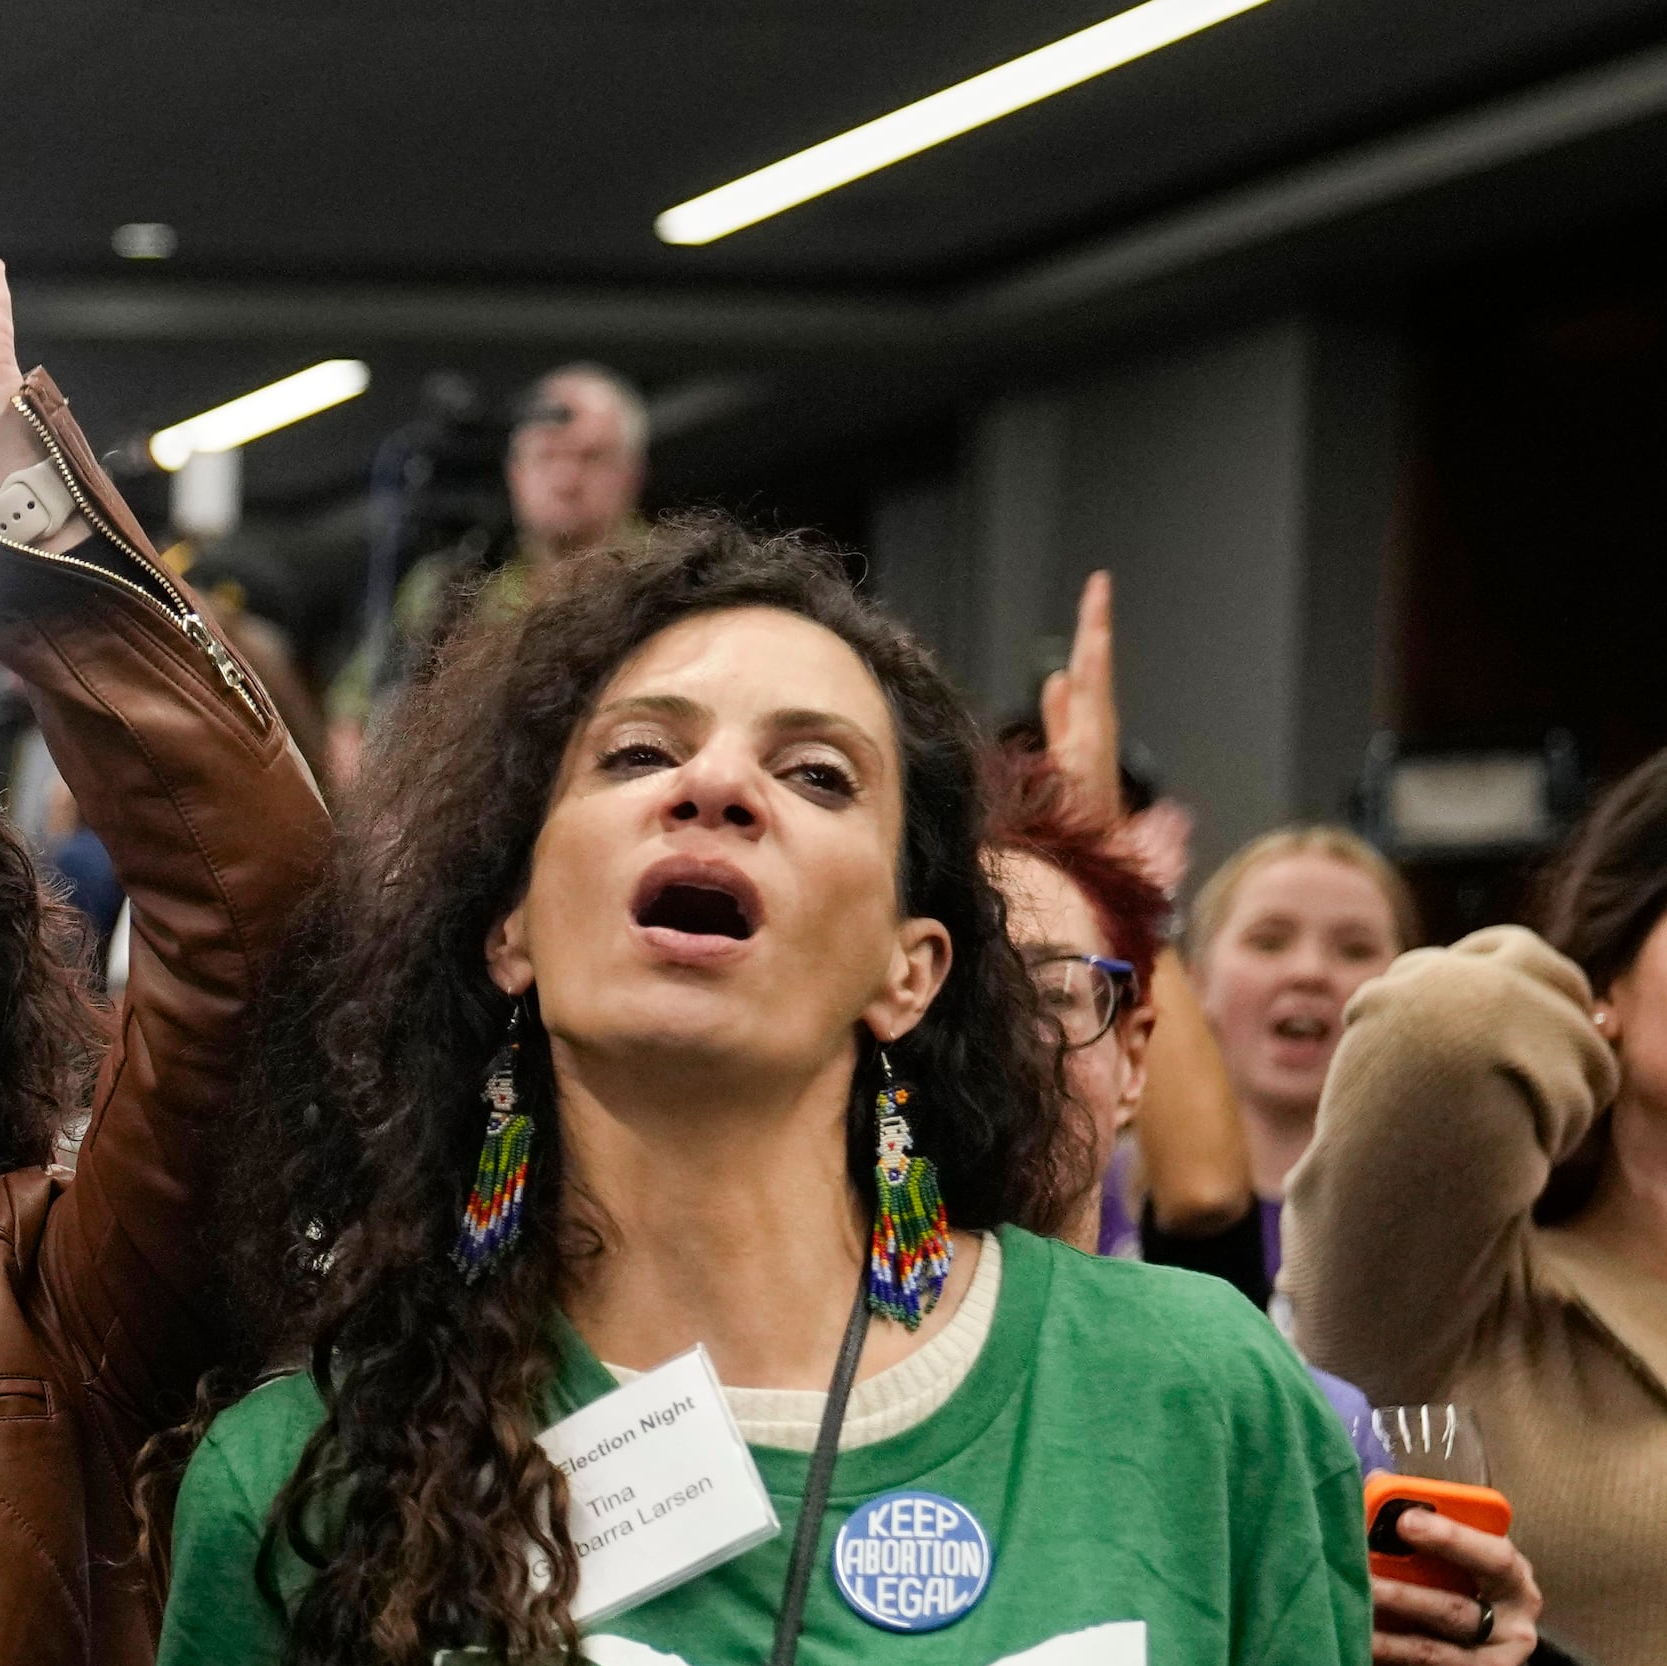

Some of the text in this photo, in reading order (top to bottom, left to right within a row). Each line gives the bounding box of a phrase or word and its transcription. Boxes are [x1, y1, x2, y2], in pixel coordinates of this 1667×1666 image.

[558, 1396, 696, 1479] Election Night
[586, 1485, 636, 1519] Tina
[637, 1476, 713, 1525] Larsen
[868, 1498, 959, 1538] KEEP
[843, 1538, 983, 1577] ABORTION
[854, 1576, 969, 1618] LEGAL
